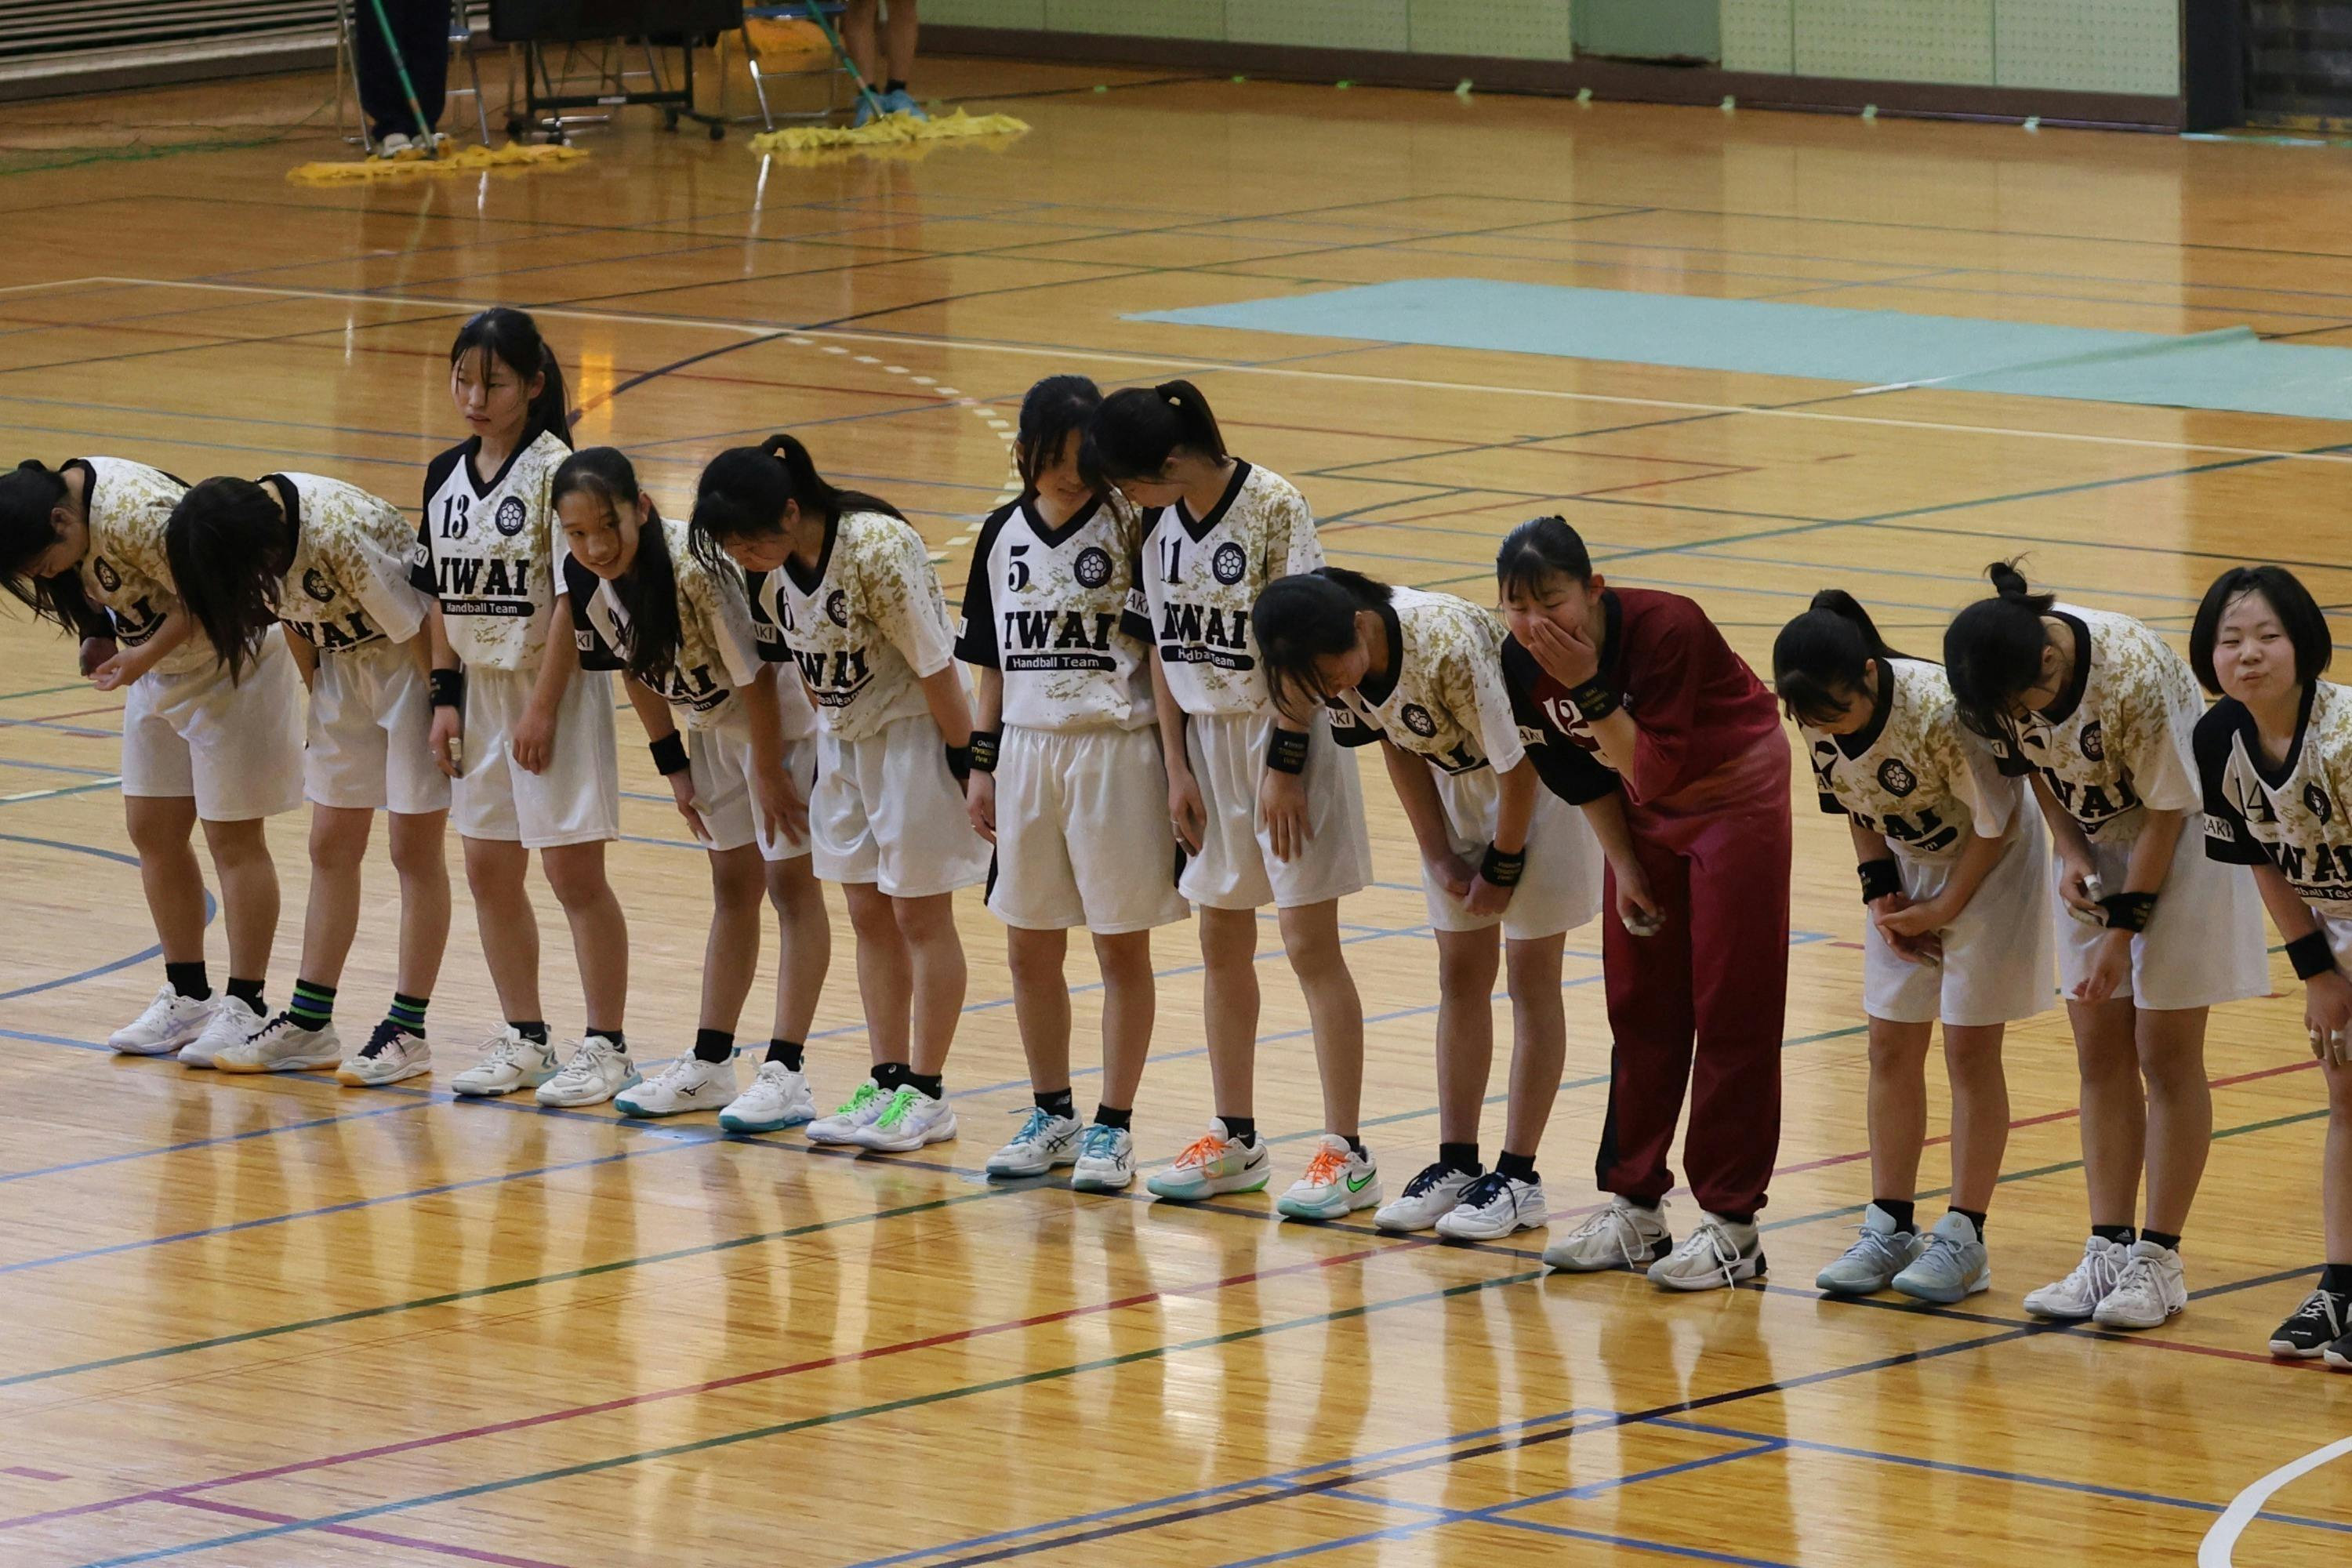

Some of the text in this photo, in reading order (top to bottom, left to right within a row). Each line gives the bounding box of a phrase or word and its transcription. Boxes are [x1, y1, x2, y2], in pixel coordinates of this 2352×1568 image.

[440, 494, 470, 539] 13
[437, 557, 530, 596] IWAI
[1008, 544, 1030, 593] 5
[1160, 535, 1183, 584] 11
[446, 602, 517, 614] Handball Team
[1160, 601, 1249, 649] IWAI
[1004, 610, 1116, 651] IWAI
[792, 647, 869, 688] WAI
[1012, 656, 1099, 669] Handball Team
[2235, 777, 2281, 823] 14
